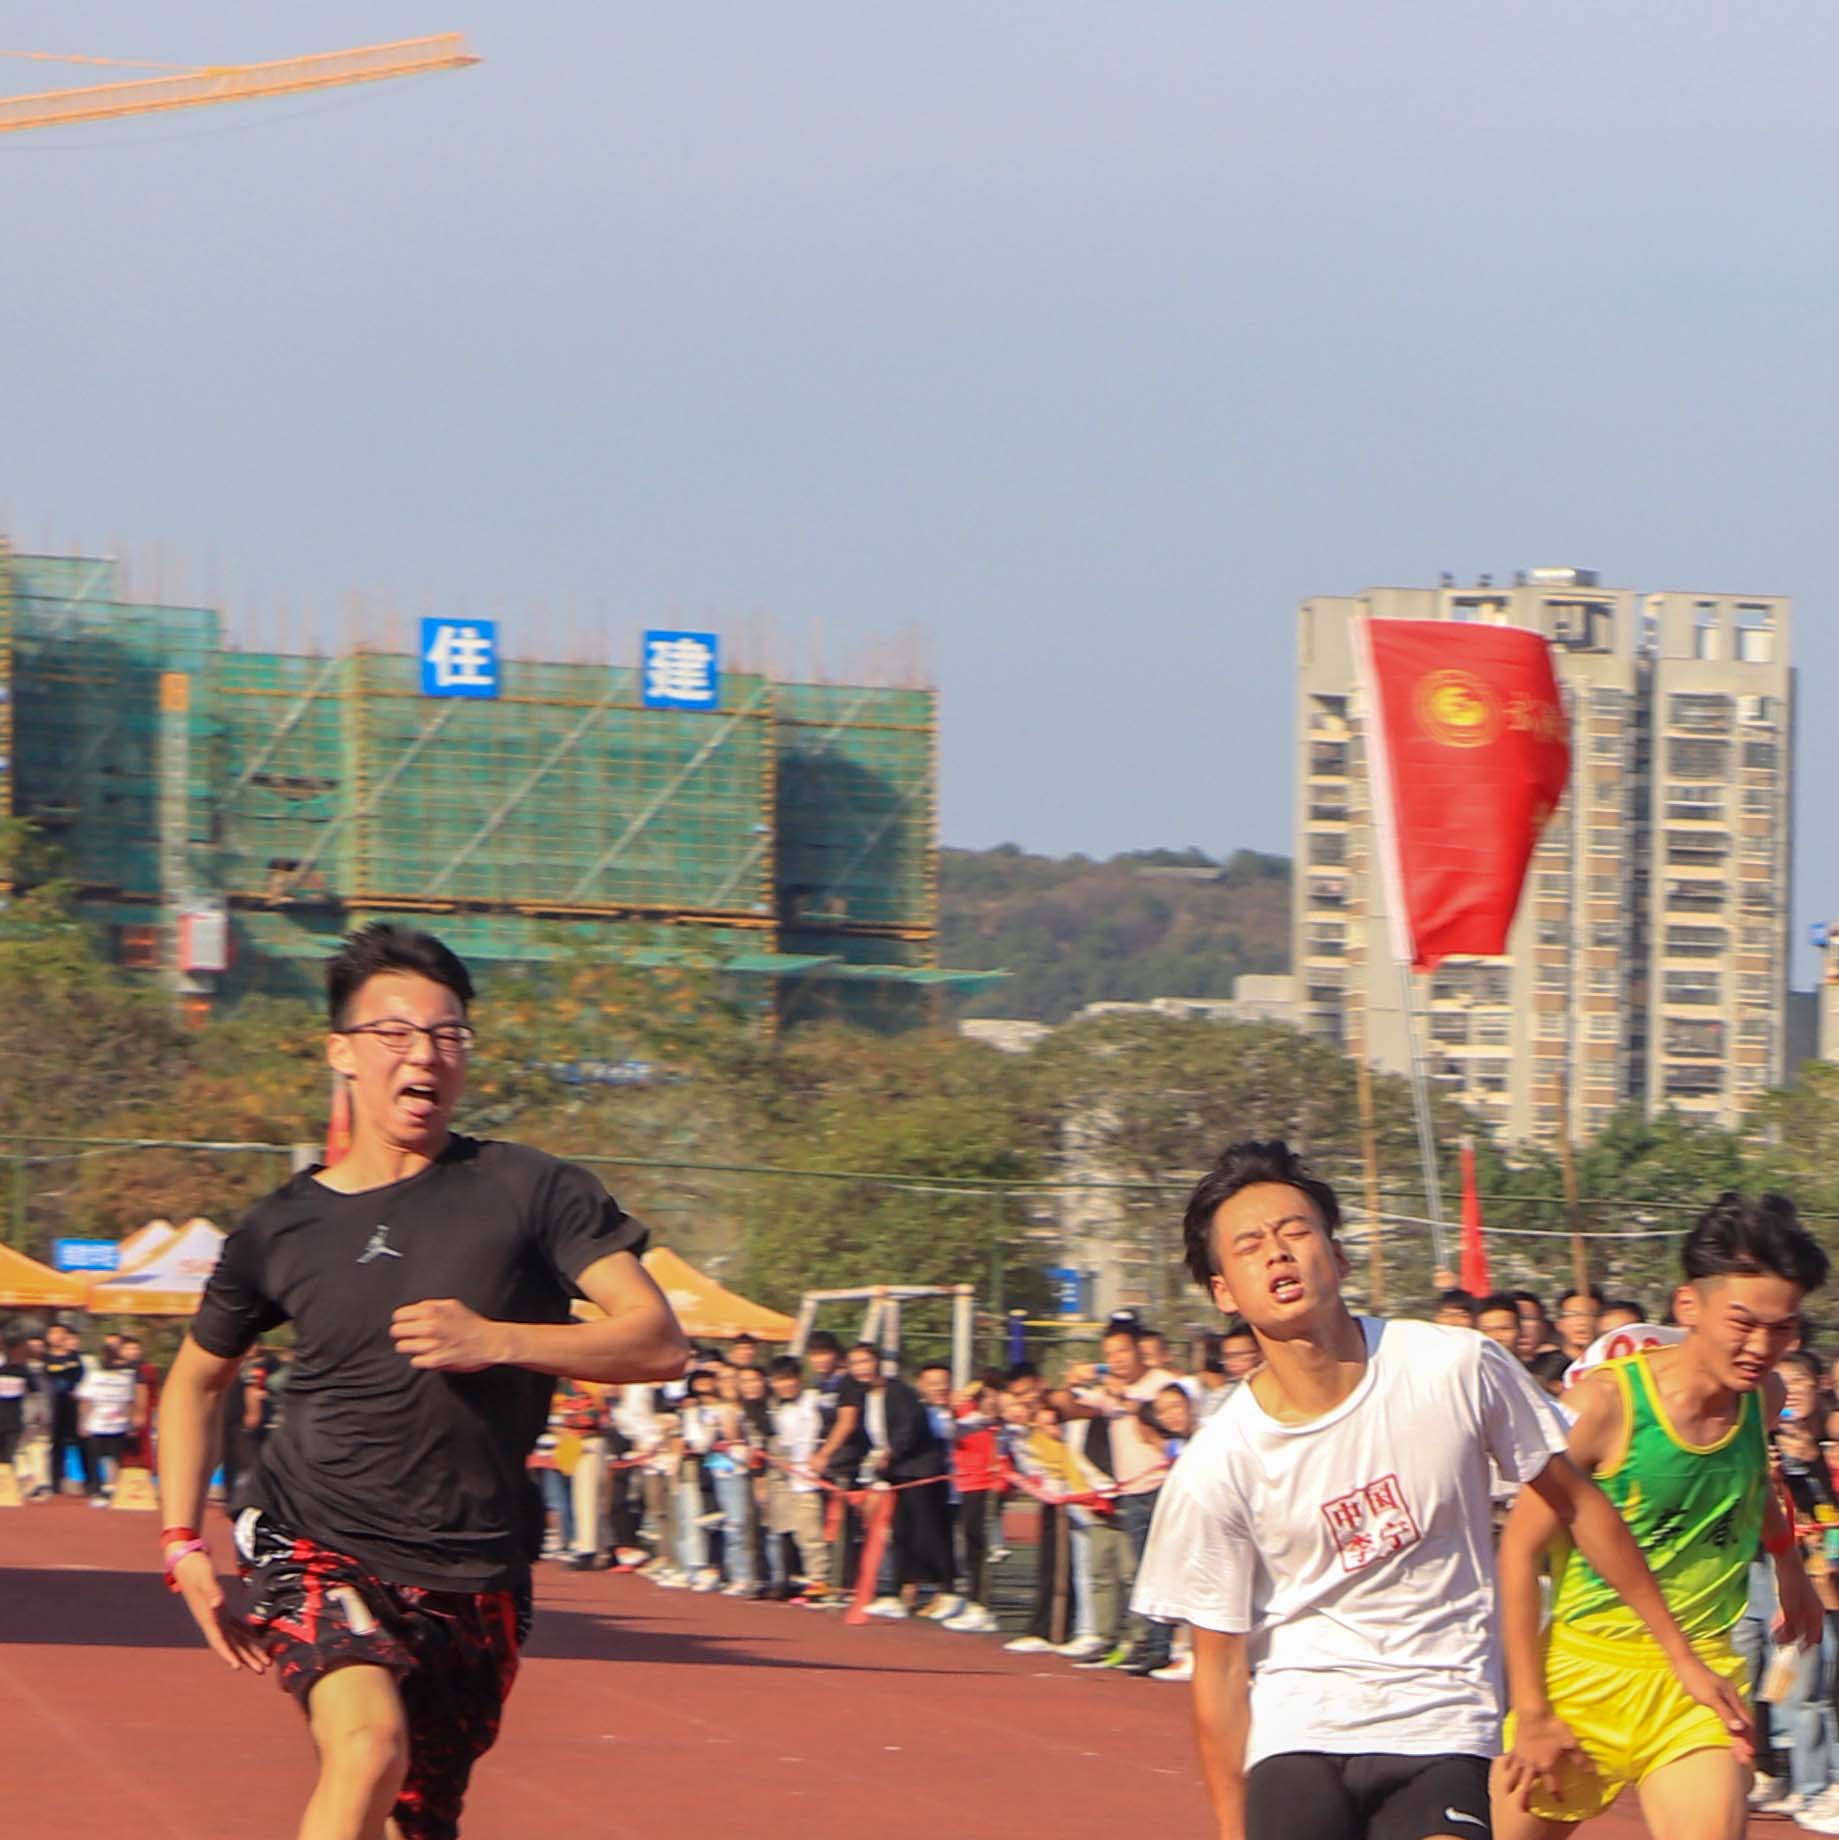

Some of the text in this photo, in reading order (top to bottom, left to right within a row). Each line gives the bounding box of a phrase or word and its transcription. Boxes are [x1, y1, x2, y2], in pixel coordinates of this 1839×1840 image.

[426, 625, 713, 700] 住 建
[1332, 1480, 1398, 1530] 中国
